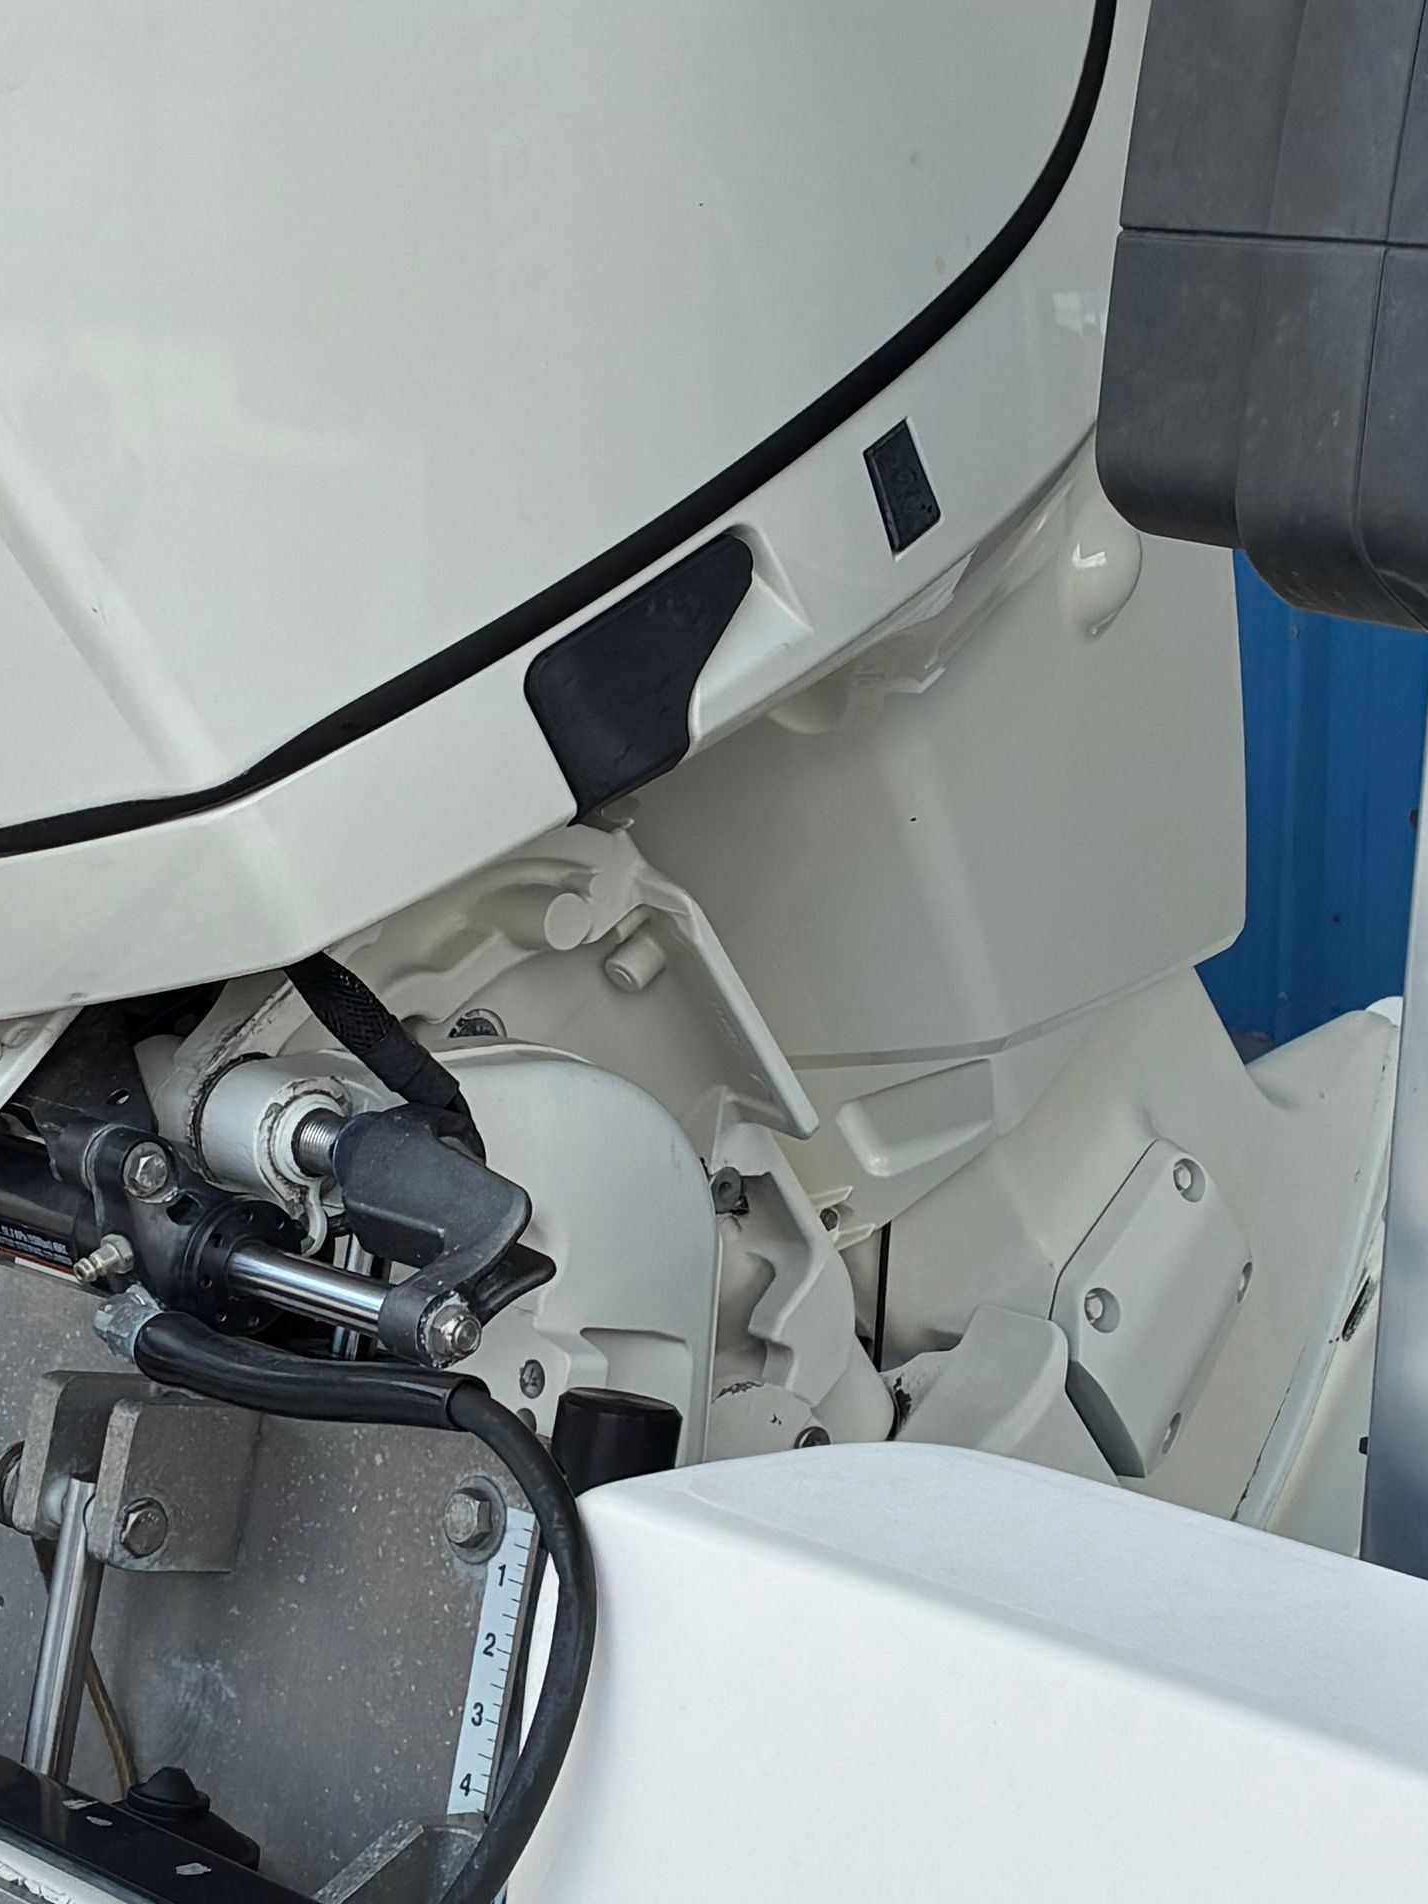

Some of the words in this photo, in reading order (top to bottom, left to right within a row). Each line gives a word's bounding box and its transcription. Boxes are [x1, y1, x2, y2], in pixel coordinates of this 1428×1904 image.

[497, 1563, 507, 1587] 1
[482, 1633, 497, 1657] 2
[471, 1702, 484, 1727] 3
[459, 1773, 472, 1797] 4
